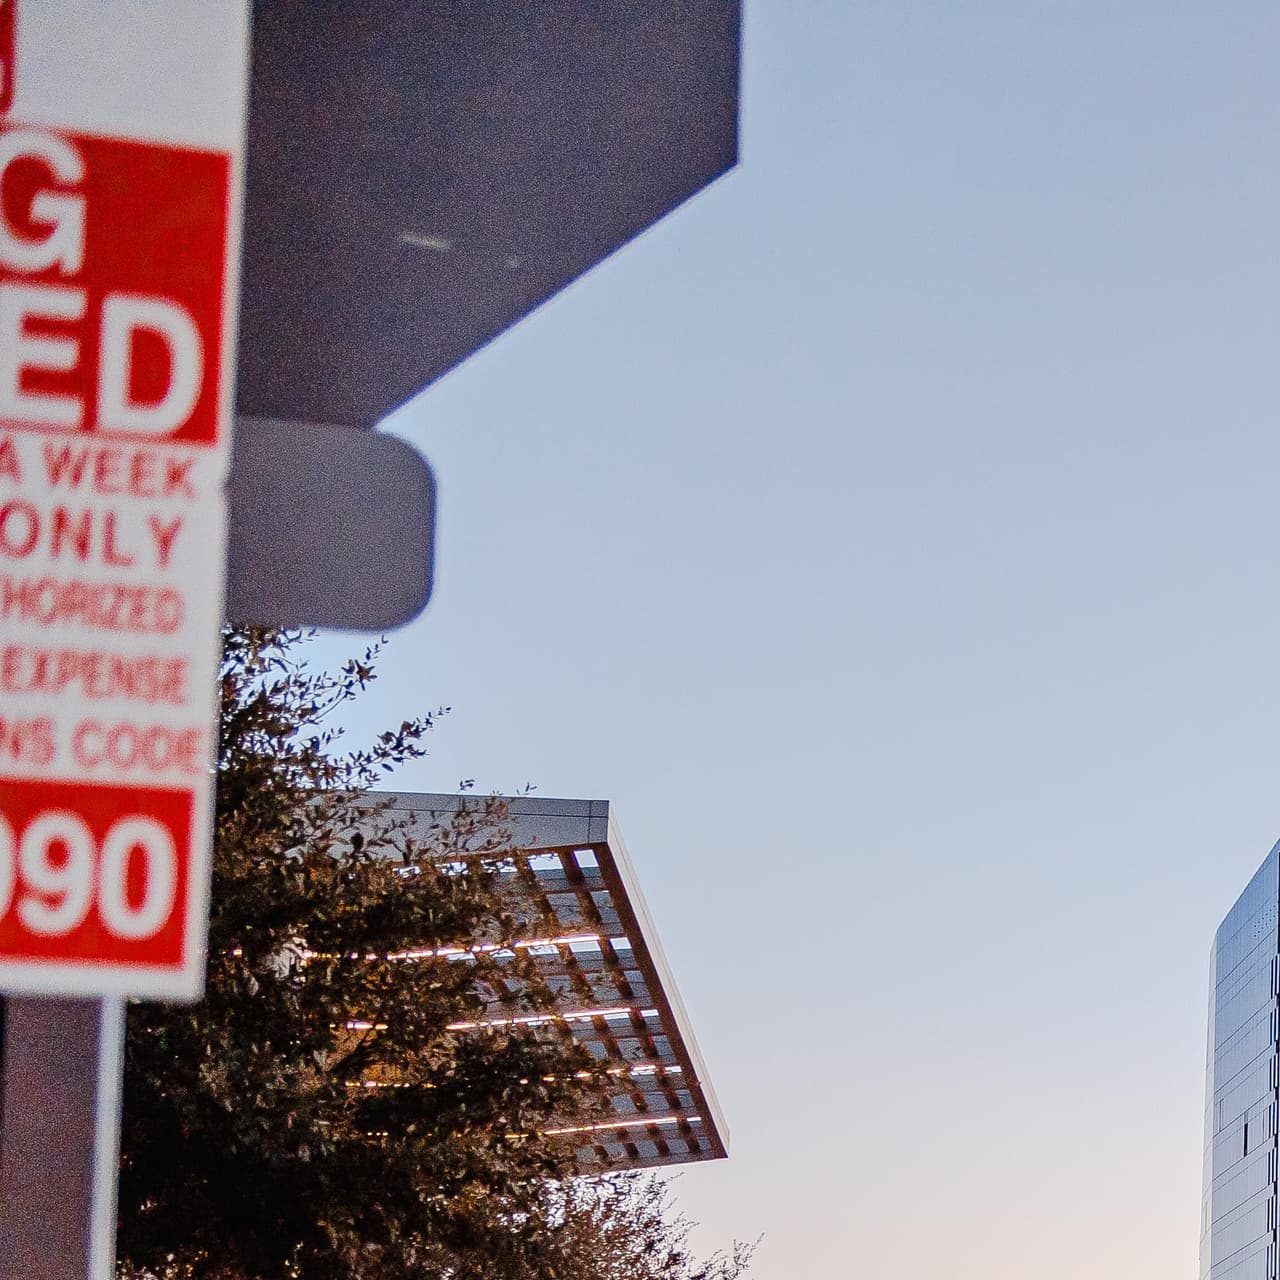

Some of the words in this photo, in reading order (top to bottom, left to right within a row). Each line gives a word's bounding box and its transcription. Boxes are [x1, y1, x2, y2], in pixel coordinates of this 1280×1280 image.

[43, 440, 198, 501] WEEK
[0, 498, 184, 569] ONLY
[0, 641, 188, 705] EXPENSE
[72, 714, 203, 777] CODE
[0, 808, 178, 940] 90
